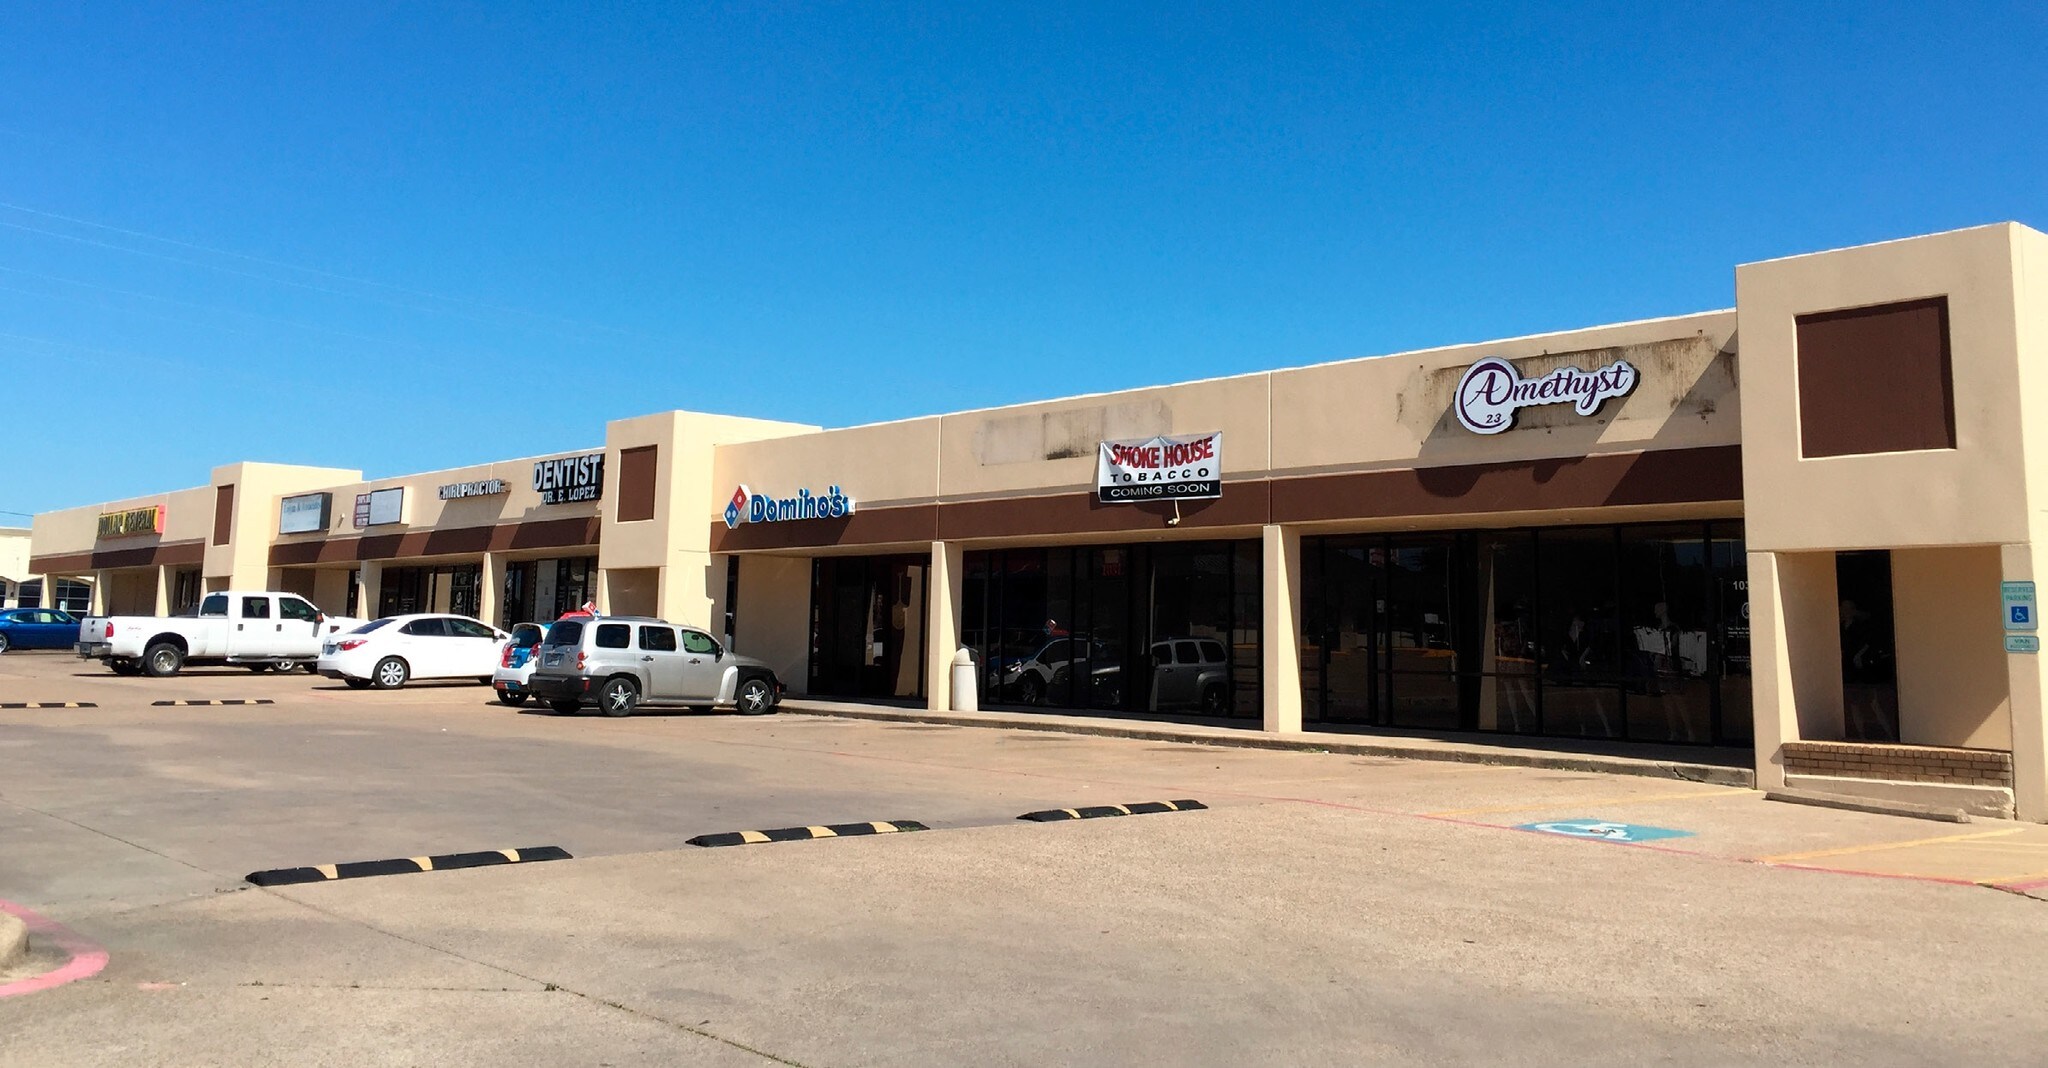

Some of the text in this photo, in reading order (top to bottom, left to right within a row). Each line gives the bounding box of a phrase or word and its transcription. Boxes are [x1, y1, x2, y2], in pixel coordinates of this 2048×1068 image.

[1462, 362, 1629, 411] Amethyst
[1486, 413, 1502, 424] 23
[1110, 437, 1214, 468] SMOKE HOUSE
[532, 455, 600, 490] DENTIST
[1111, 468, 1209, 482] TOBACCO
[542, 485, 596, 503] DR. E. LOPEZ
[1110, 483, 1210, 497] COMING SOON
[749, 485, 846, 523] Domino's
[125, 508, 156, 532] GENERAL
